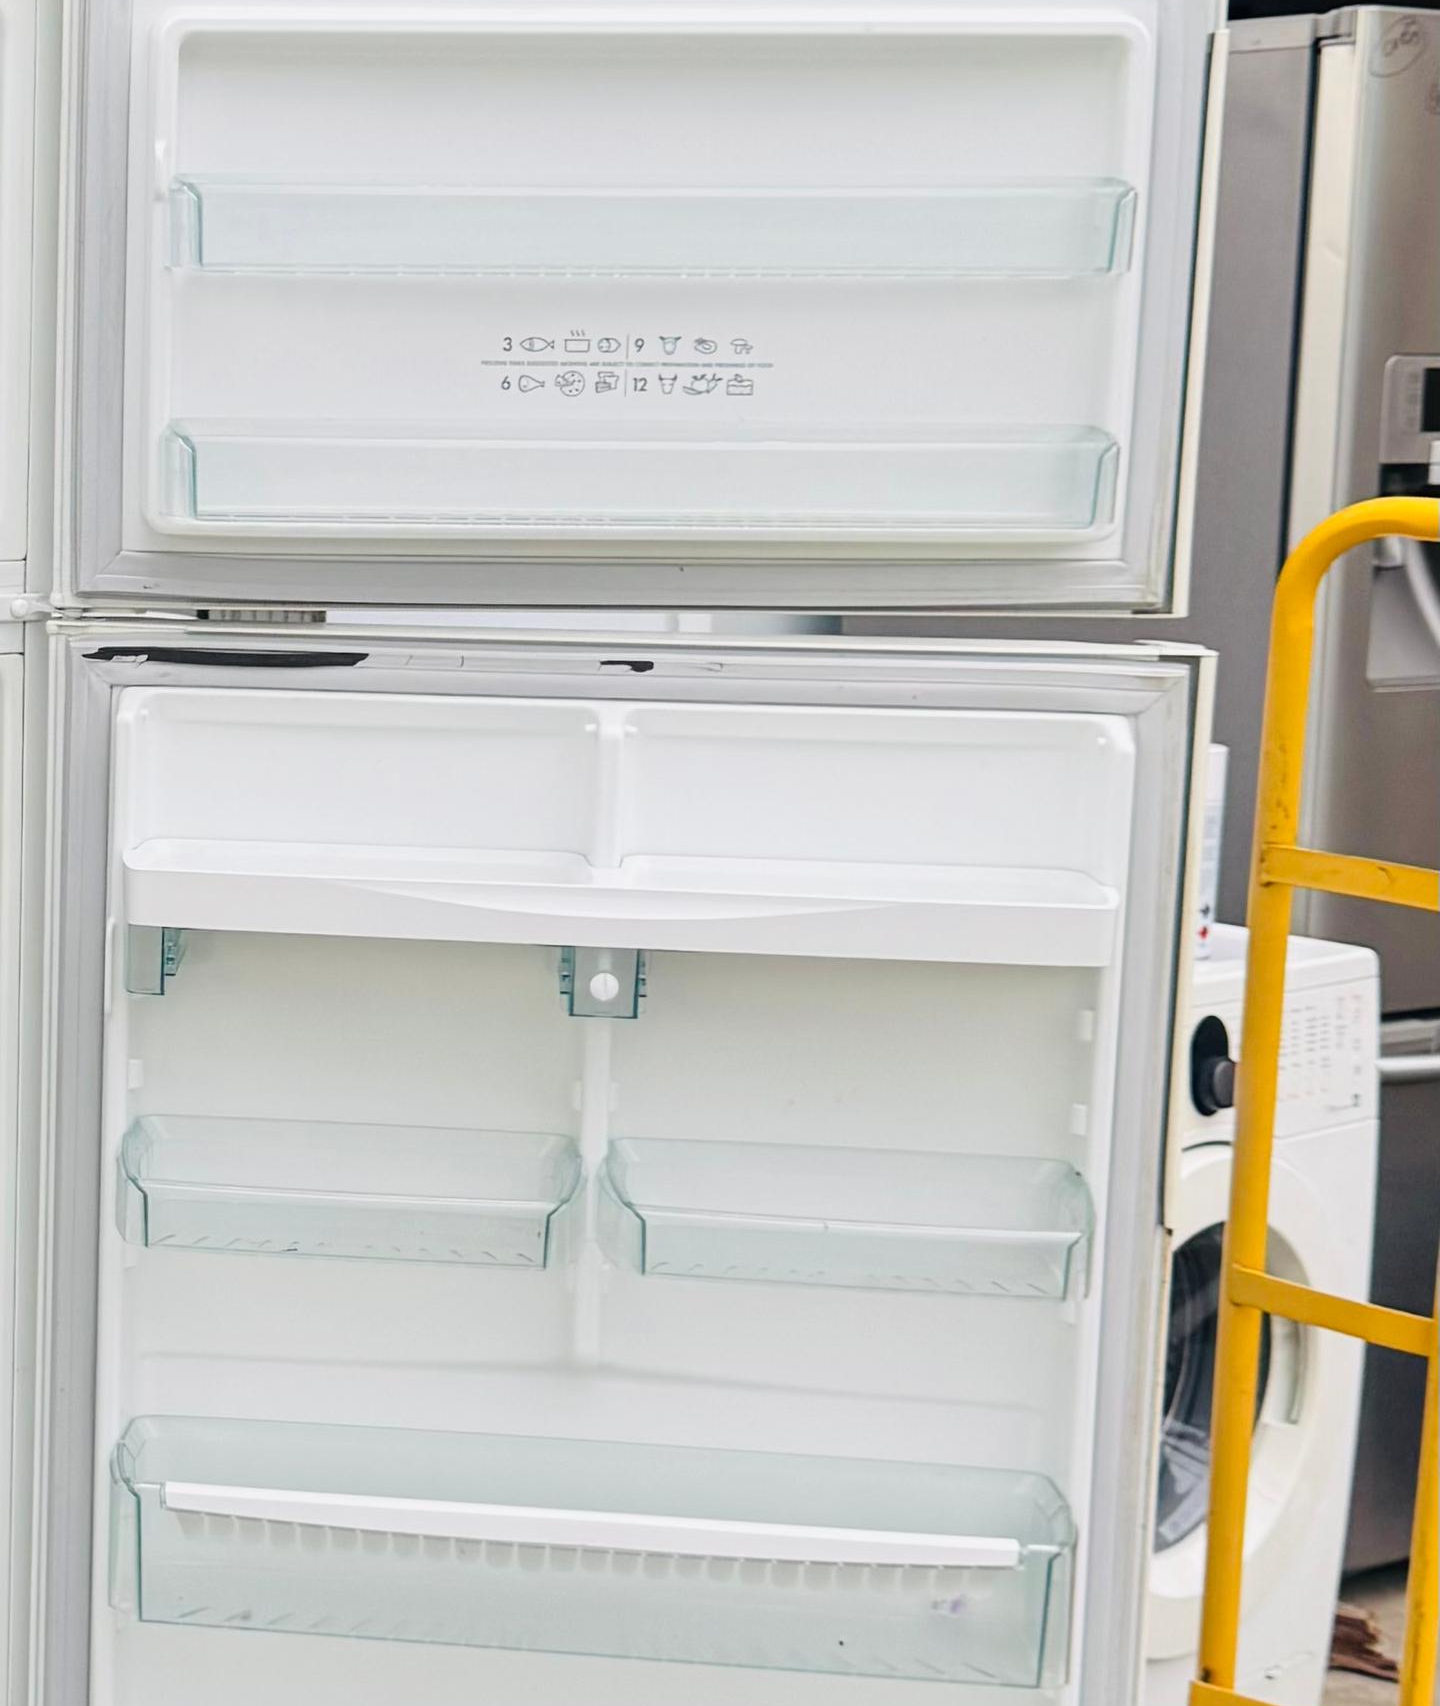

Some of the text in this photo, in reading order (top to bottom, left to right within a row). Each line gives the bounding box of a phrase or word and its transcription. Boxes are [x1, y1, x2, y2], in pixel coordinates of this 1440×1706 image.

[503, 336, 513, 352] 3
[634, 337, 645, 353] 9
[501, 375, 511, 391] 6
[633, 377, 648, 392] 12
